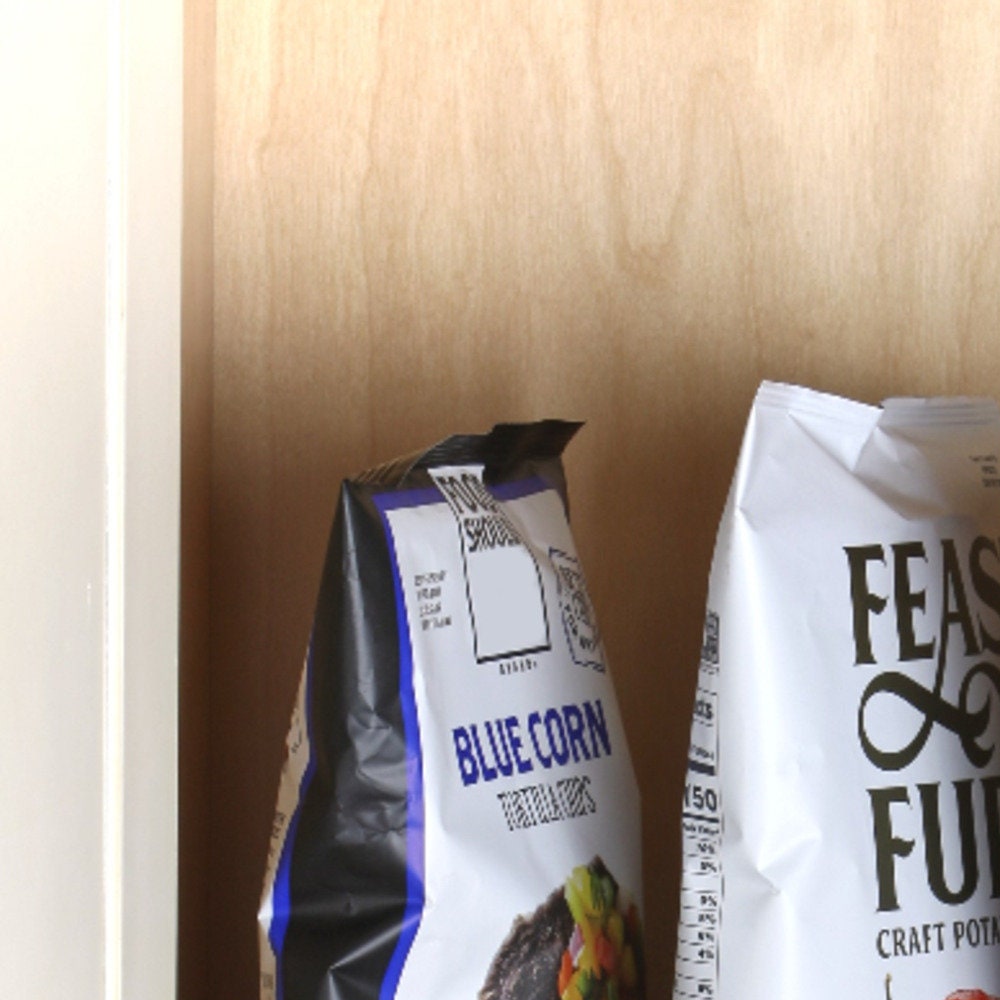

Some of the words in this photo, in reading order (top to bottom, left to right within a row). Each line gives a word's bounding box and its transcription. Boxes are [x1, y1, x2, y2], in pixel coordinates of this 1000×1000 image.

[452, 715, 533, 787] BLUE
[527, 698, 612, 768] CORN
[876, 922, 946, 959] CRAFT
